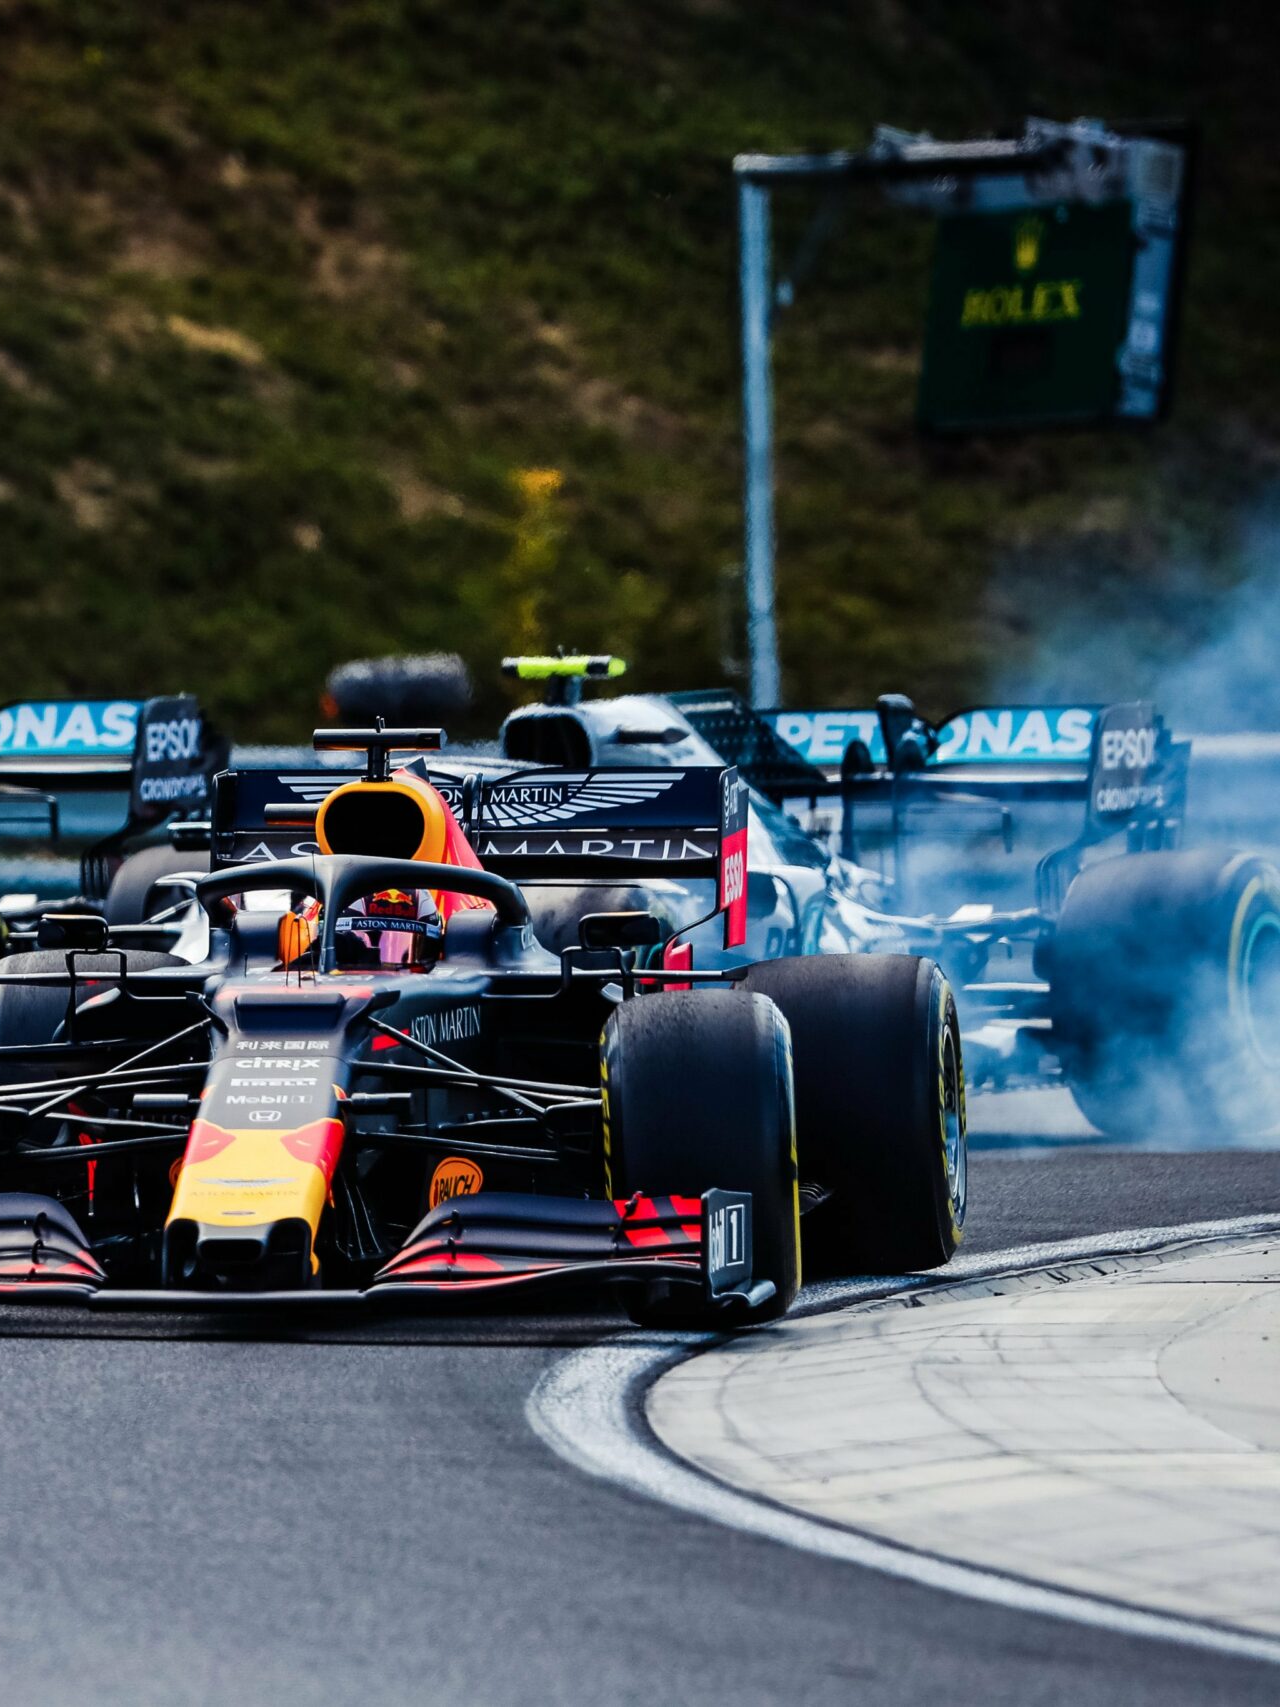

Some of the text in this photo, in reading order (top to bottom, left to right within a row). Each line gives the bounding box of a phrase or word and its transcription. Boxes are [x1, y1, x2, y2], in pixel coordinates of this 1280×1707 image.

[961, 280, 1081, 326] ROLEX
[776, 709, 1092, 759] PETONAS
[489, 787, 563, 804] MARTIN
[356, 920, 388, 929] ASTON
[390, 921, 424, 932] MARTIN
[410, 1004, 481, 1046] ASTON MARTIN
[230, 1078, 318, 1087] PIRELLI
[226, 1095, 288, 1104] Mobil
